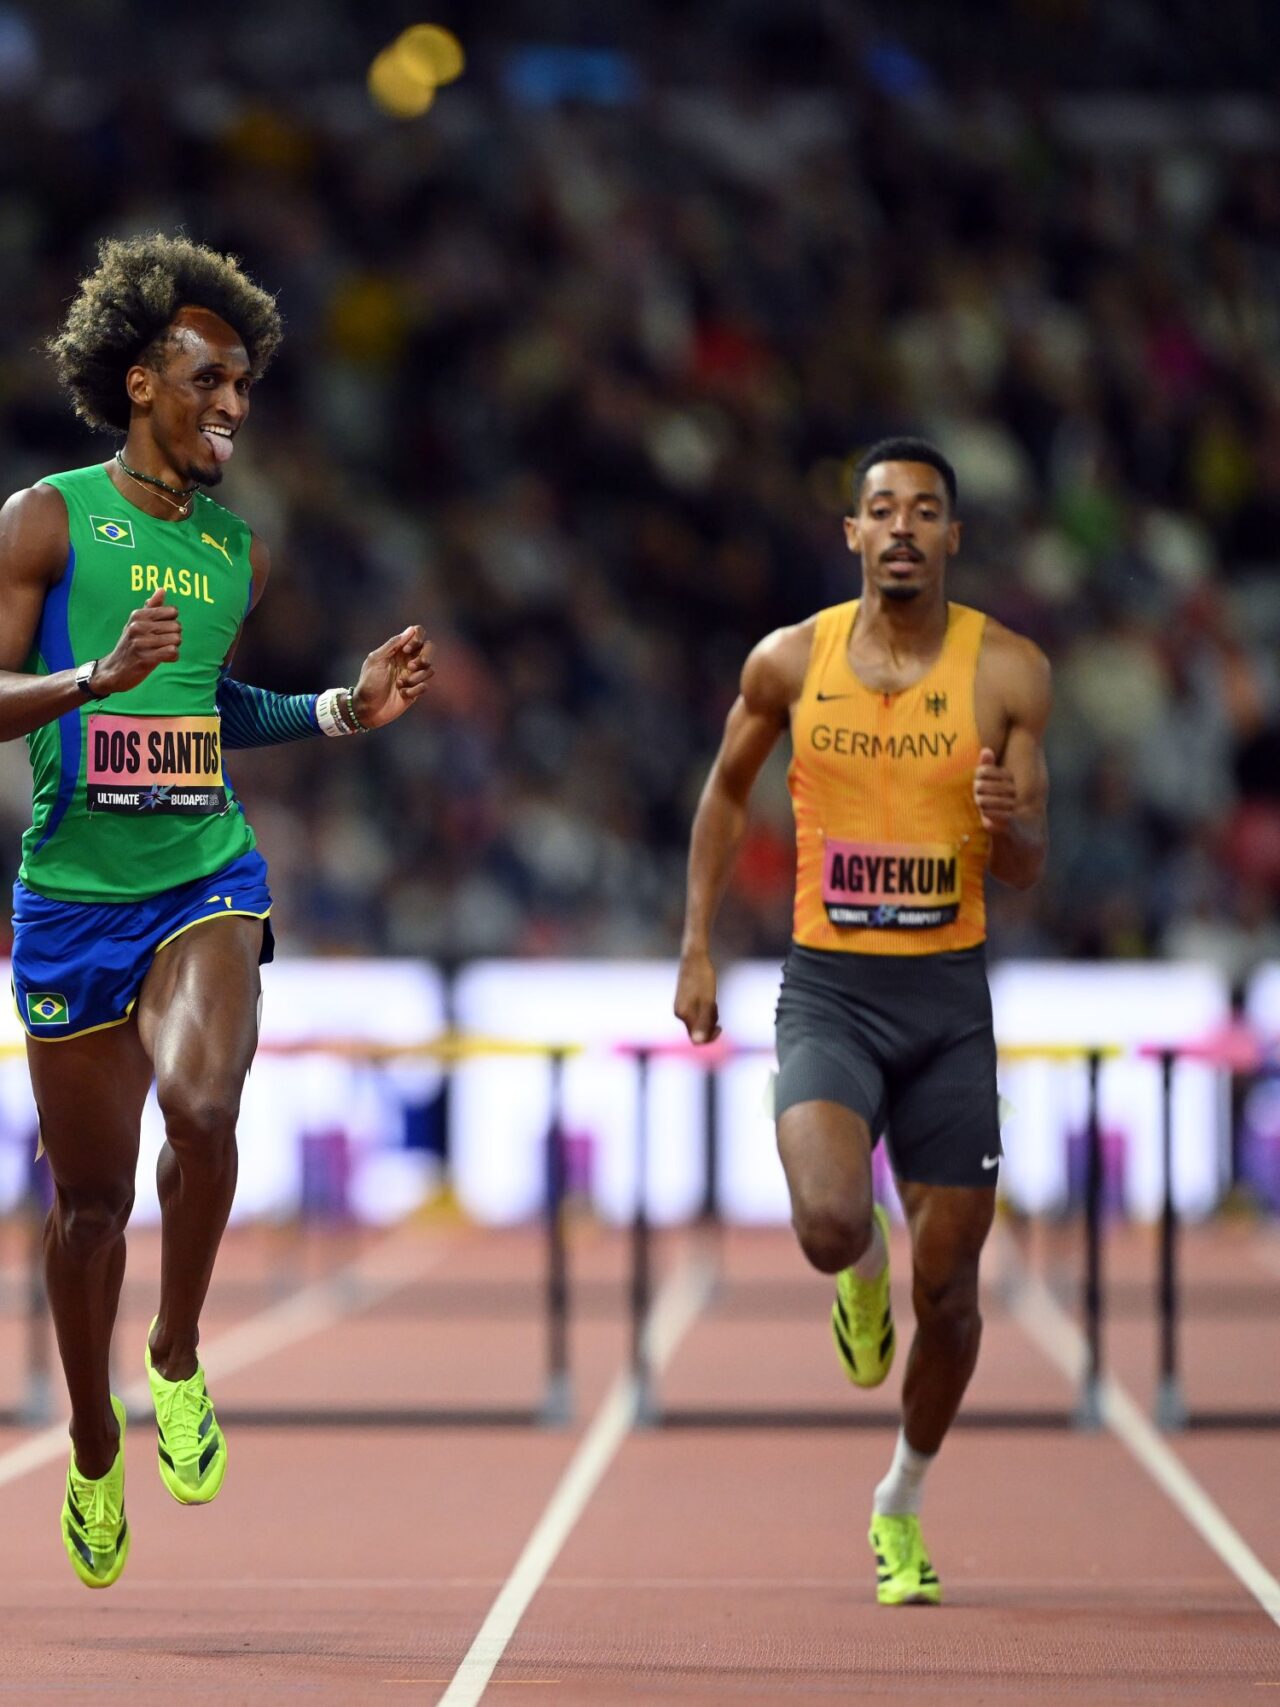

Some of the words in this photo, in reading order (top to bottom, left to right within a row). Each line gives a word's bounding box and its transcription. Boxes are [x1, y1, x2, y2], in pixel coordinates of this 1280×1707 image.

[131, 564, 214, 604] BRASIL
[94, 730, 141, 774] DOS
[147, 731, 219, 775] SANTOS
[811, 725, 958, 758] GERMANY
[97, 792, 140, 806] ULTIMATE
[171, 794, 209, 806] BUDAPEST
[830, 853, 957, 895] AGYEKUM
